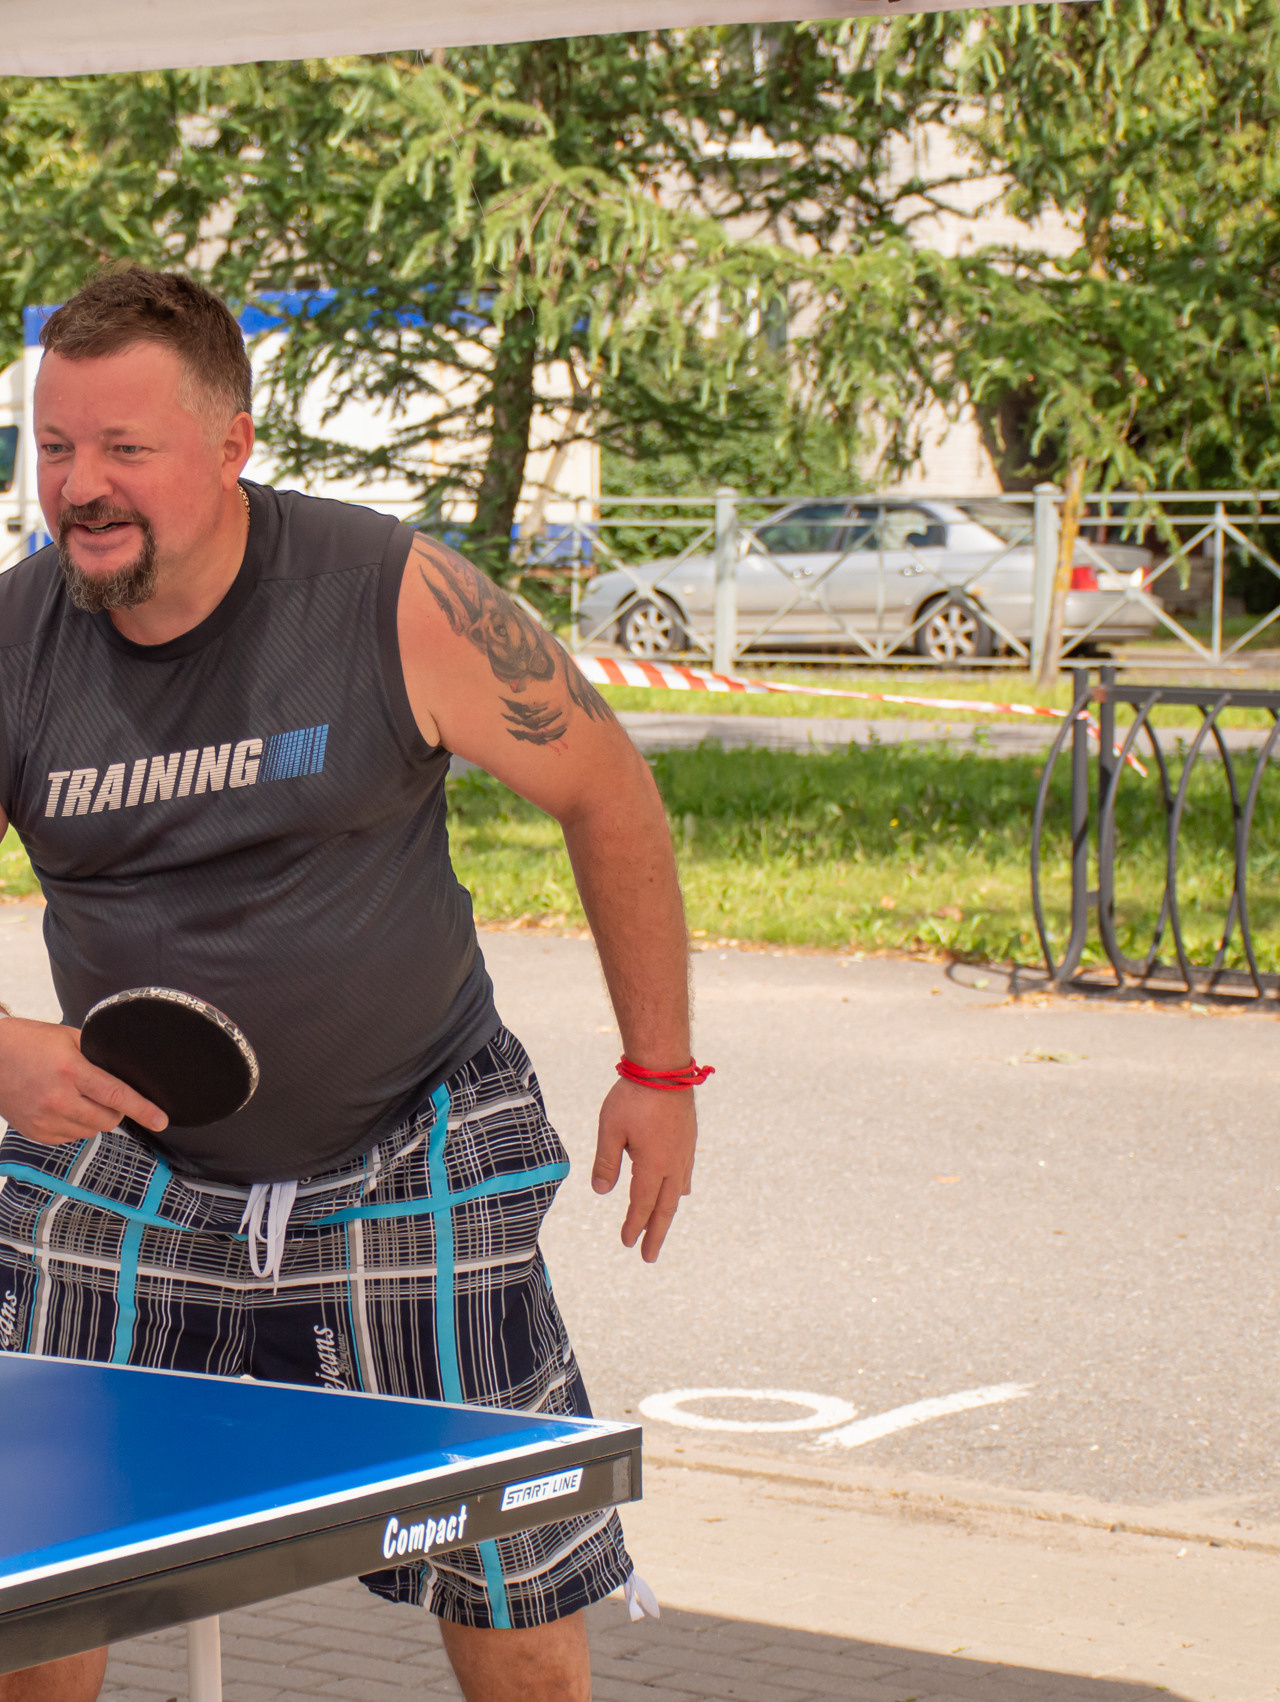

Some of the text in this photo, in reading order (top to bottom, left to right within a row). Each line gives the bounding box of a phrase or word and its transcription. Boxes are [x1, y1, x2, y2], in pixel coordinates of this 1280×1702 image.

[45, 738, 263, 818] TRAINING
[506, 1474, 578, 1505] START LINE
[383, 1504, 467, 1559] Compact
